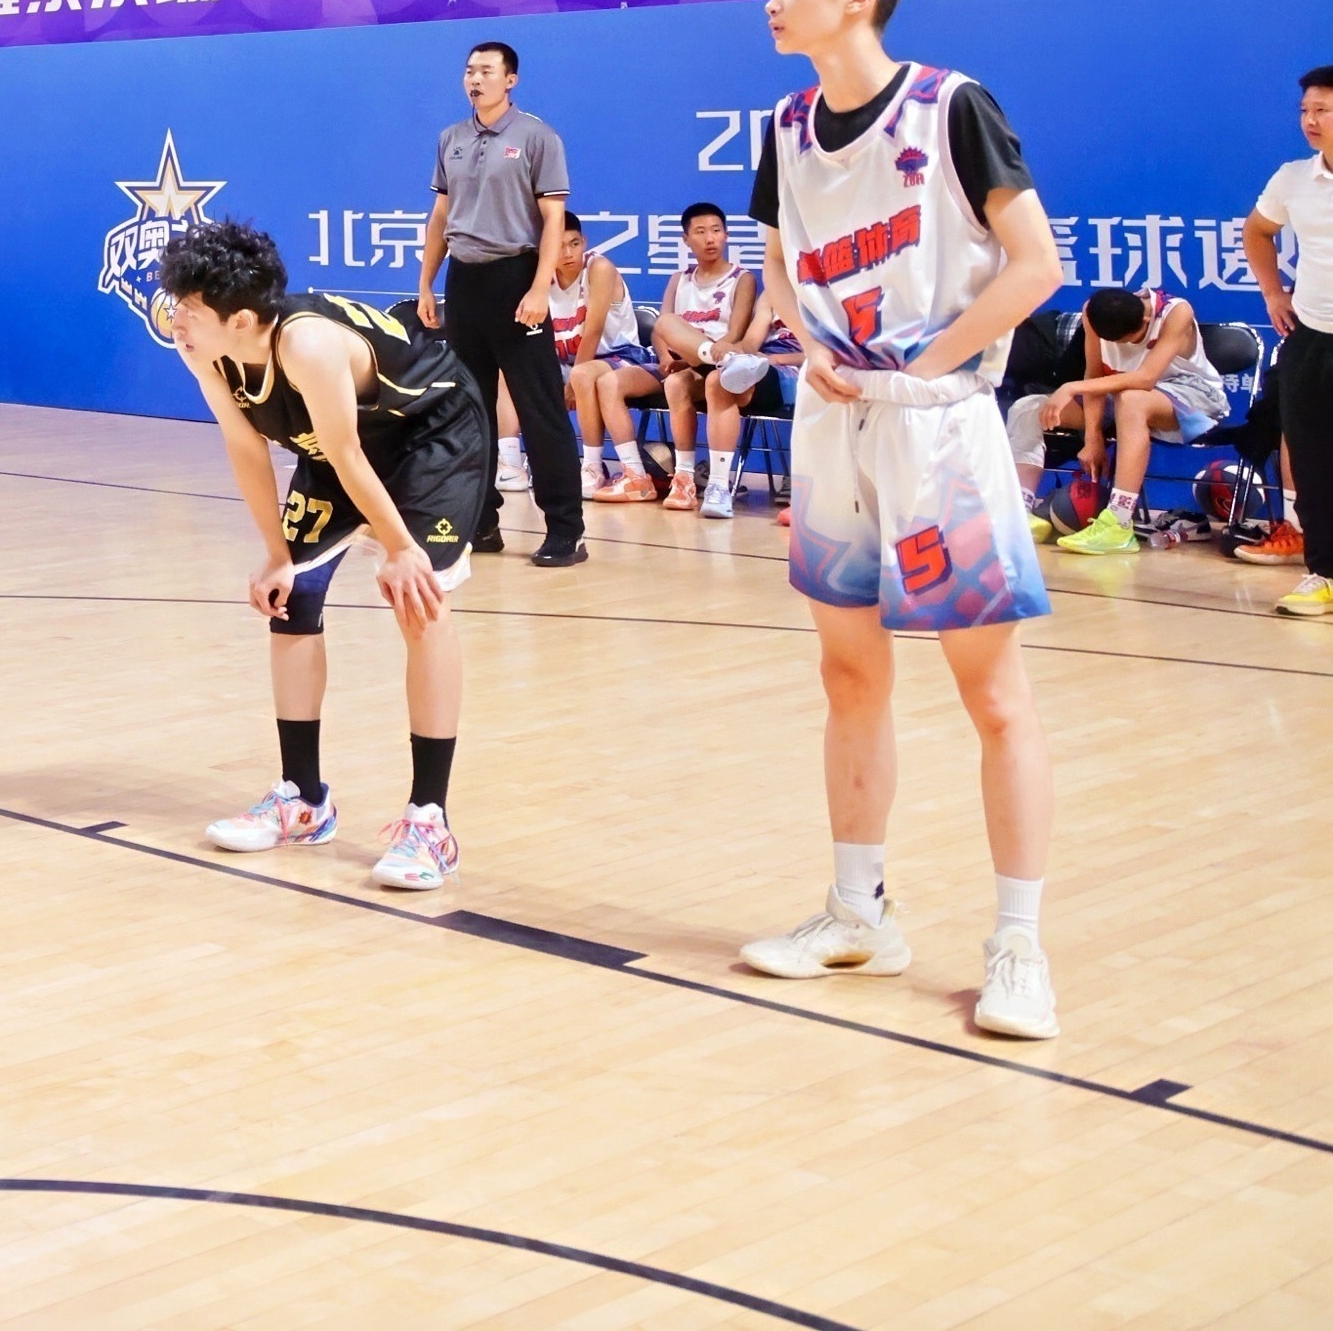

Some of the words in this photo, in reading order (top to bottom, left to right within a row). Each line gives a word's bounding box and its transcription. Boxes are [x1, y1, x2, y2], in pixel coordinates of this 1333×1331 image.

[841, 286, 886, 347] 5
[283, 490, 333, 543] 27
[895, 524, 953, 597] 5
